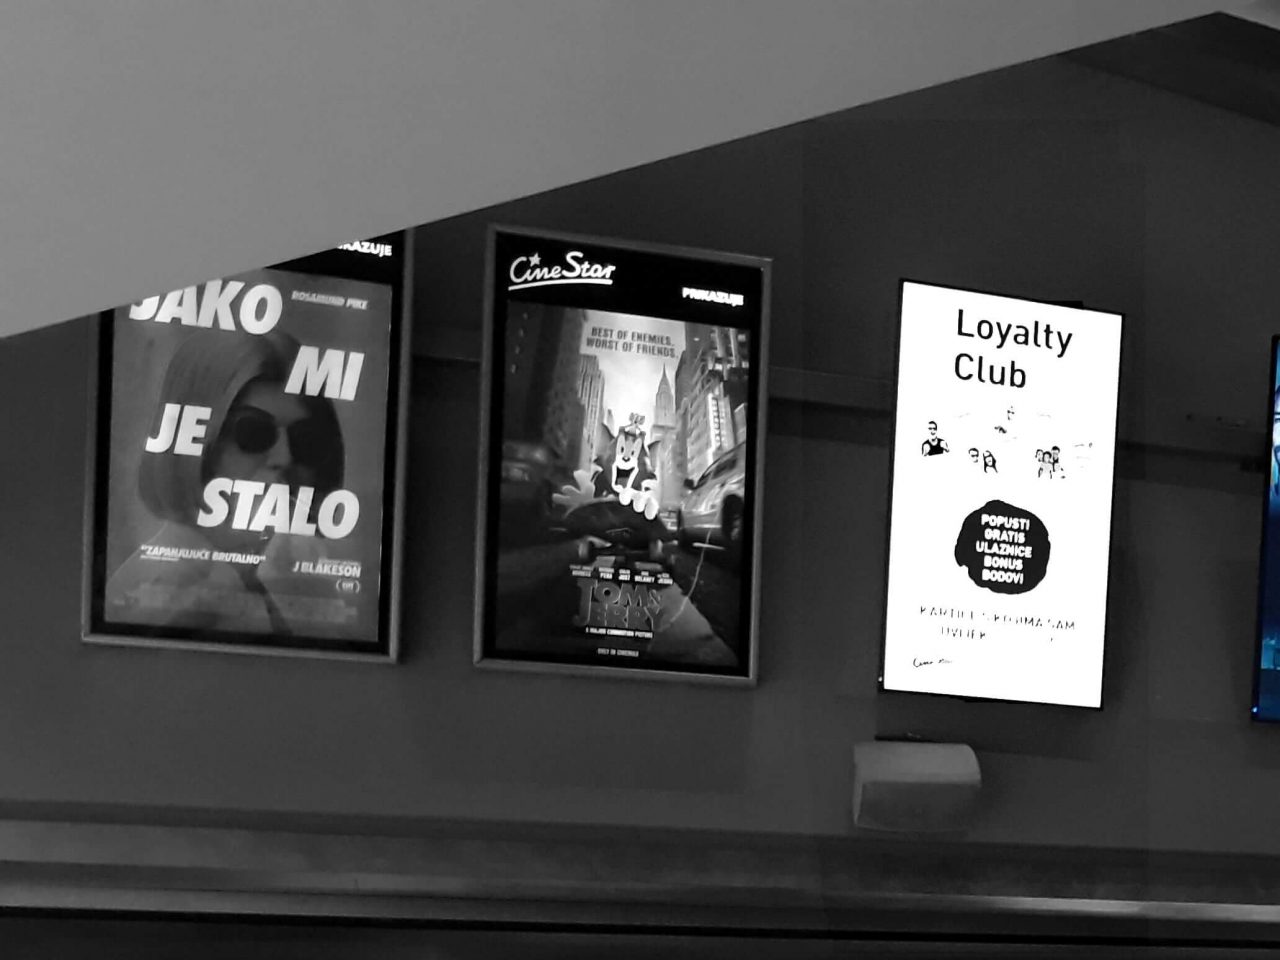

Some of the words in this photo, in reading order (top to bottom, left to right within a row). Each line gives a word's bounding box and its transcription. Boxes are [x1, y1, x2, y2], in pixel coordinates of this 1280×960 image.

[338, 241, 392, 257] KAZUJE
[509, 251, 616, 284] CineStar
[591, 327, 615, 339] BEST
[617, 329, 630, 340] OF
[957, 309, 1072, 358] Loyalty
[622, 341, 635, 353] OF
[284, 345, 365, 401] MI
[954, 353, 1027, 388] Club
[145, 403, 212, 456] JE
[197, 477, 360, 539] STALO
[981, 514, 1030, 531] POPUSTI
[985, 529, 1025, 544] GRATIS
[976, 541, 1032, 558] ULAZNICE
[984, 555, 1023, 570] BONUS
[982, 569, 1024, 585] BODOVI
